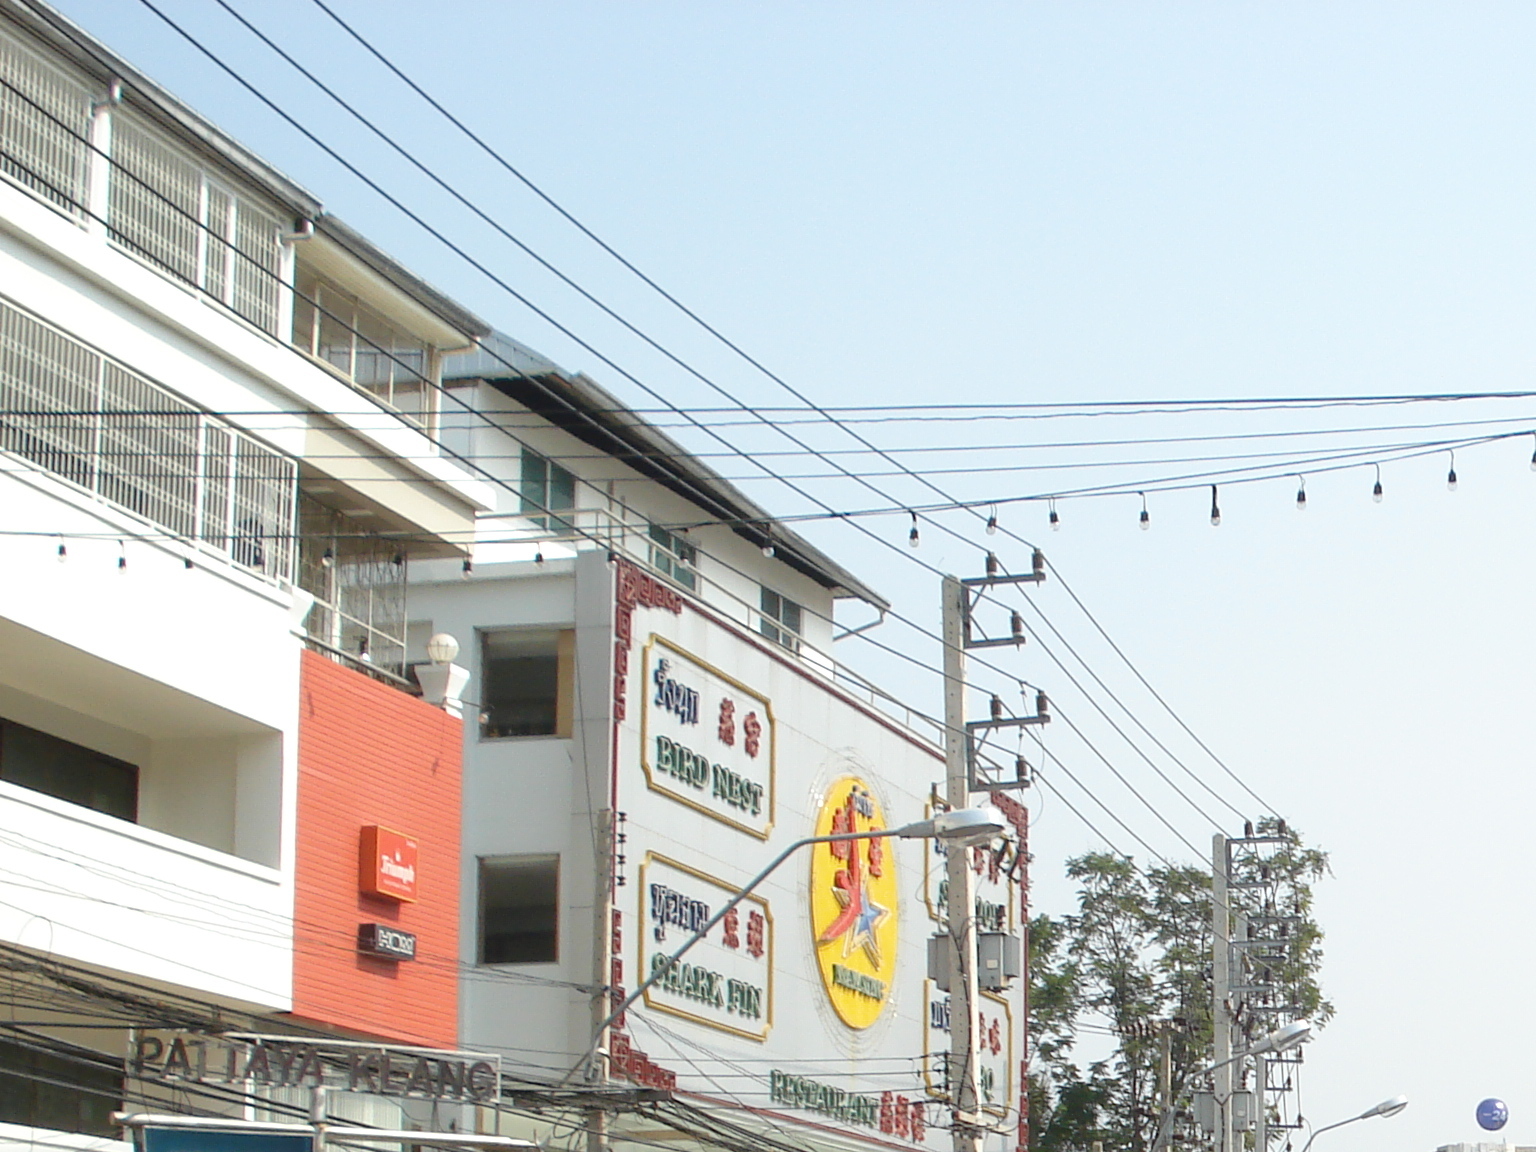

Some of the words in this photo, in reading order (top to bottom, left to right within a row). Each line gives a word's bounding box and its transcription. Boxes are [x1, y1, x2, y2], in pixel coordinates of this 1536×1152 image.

[656, 735, 711, 790] BIRD
[712, 763, 764, 816] NEST
[380, 854, 416, 885] Triumph
[651, 951, 724, 1008] SHARK
[727, 977, 763, 1019] FIN
[134, 1035, 325, 1089] PATTAYA
[346, 1048, 499, 1100] KLANG
[770, 1069, 880, 1129] RESTAURANT
